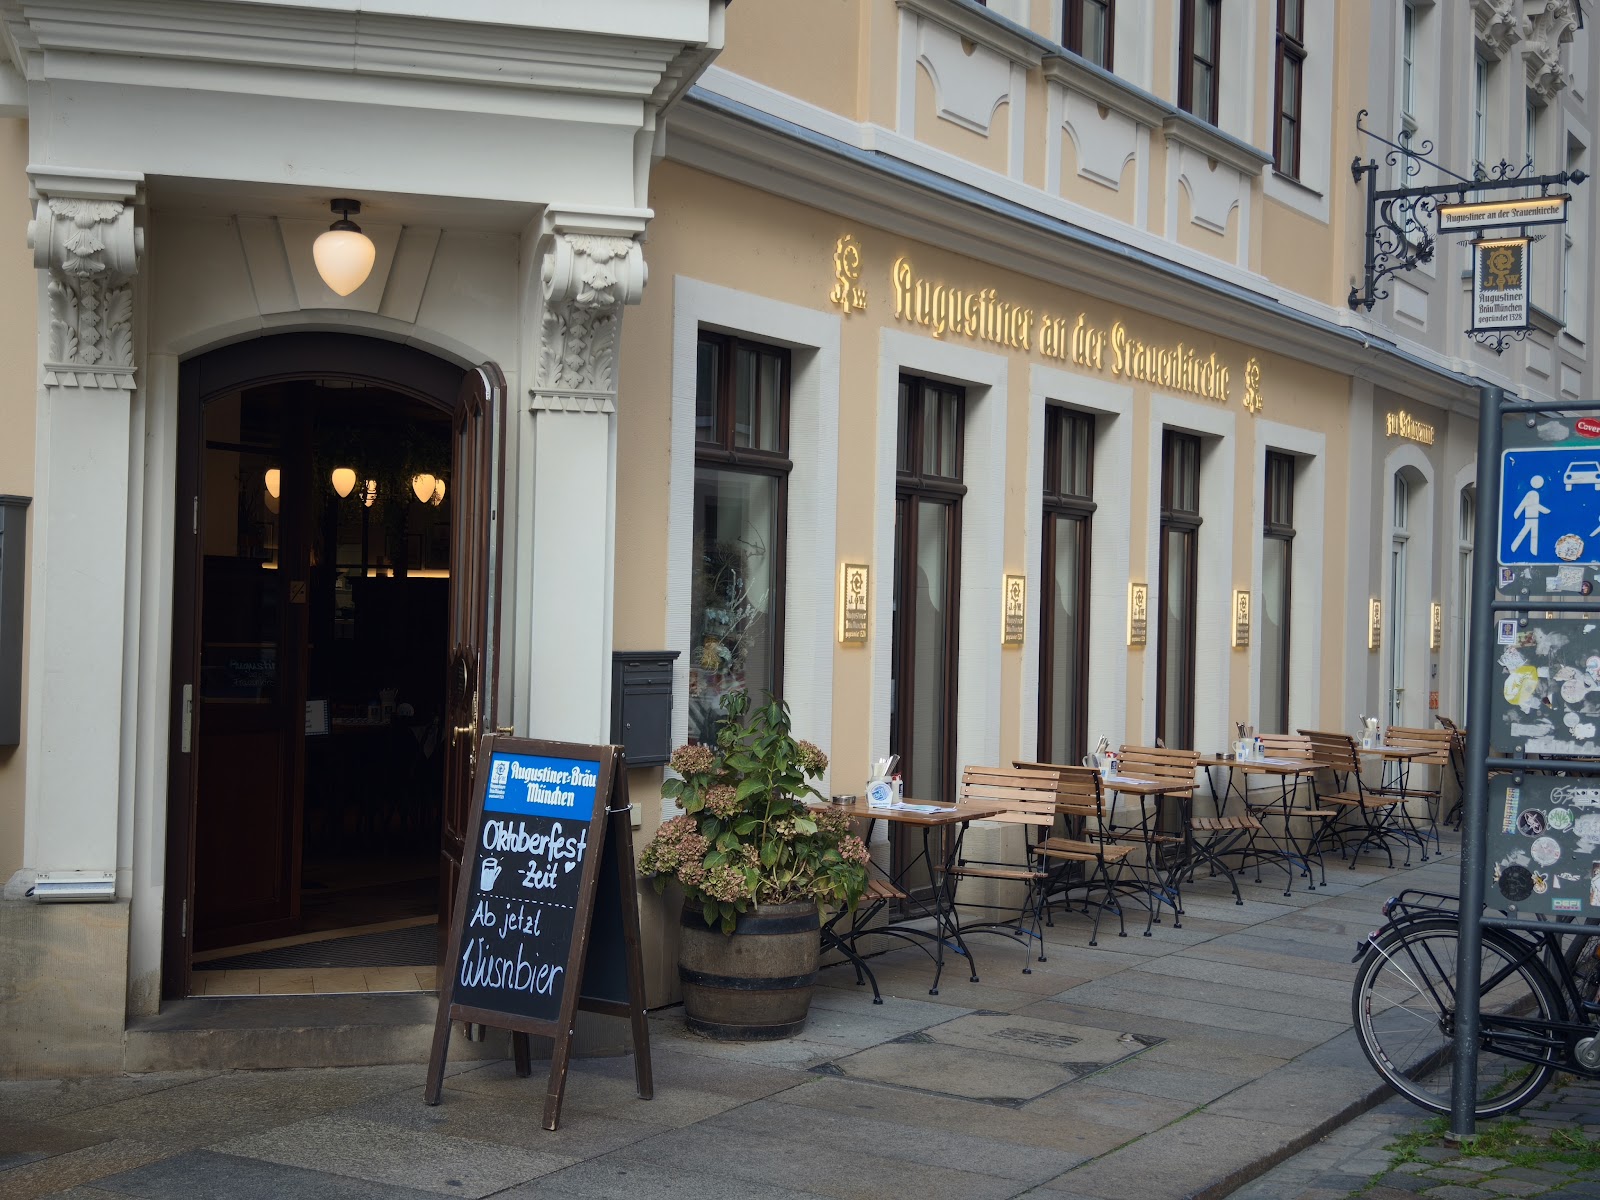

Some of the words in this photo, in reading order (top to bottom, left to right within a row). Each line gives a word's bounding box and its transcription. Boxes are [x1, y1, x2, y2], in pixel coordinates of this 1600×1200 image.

[1446, 213, 1485, 223] Augustiner
[1487, 211, 1497, 219] an
[1498, 209, 1509, 218] der
[1511, 205, 1559, 217] Frauenkirche
[1484, 276, 1496, 287] J.
[1505, 274, 1520, 286] W.
[1478, 314, 1508, 324] gegründet
[1509, 313, 1522, 321] 1328
[1479, 304, 1494, 314] Bräu
[1494, 303, 1522, 313] München
[893, 257, 1034, 351] Augustiner
[1039, 314, 1066, 360] an
[1072, 312, 1107, 370] der
[1111, 320, 1231, 401] Frauenkirche
[527, 782, 575, 807] München
[483, 820, 587, 862] Oktoberfest
[469, 900, 497, 927] Ab
[499, 902, 541, 939] jetzt
